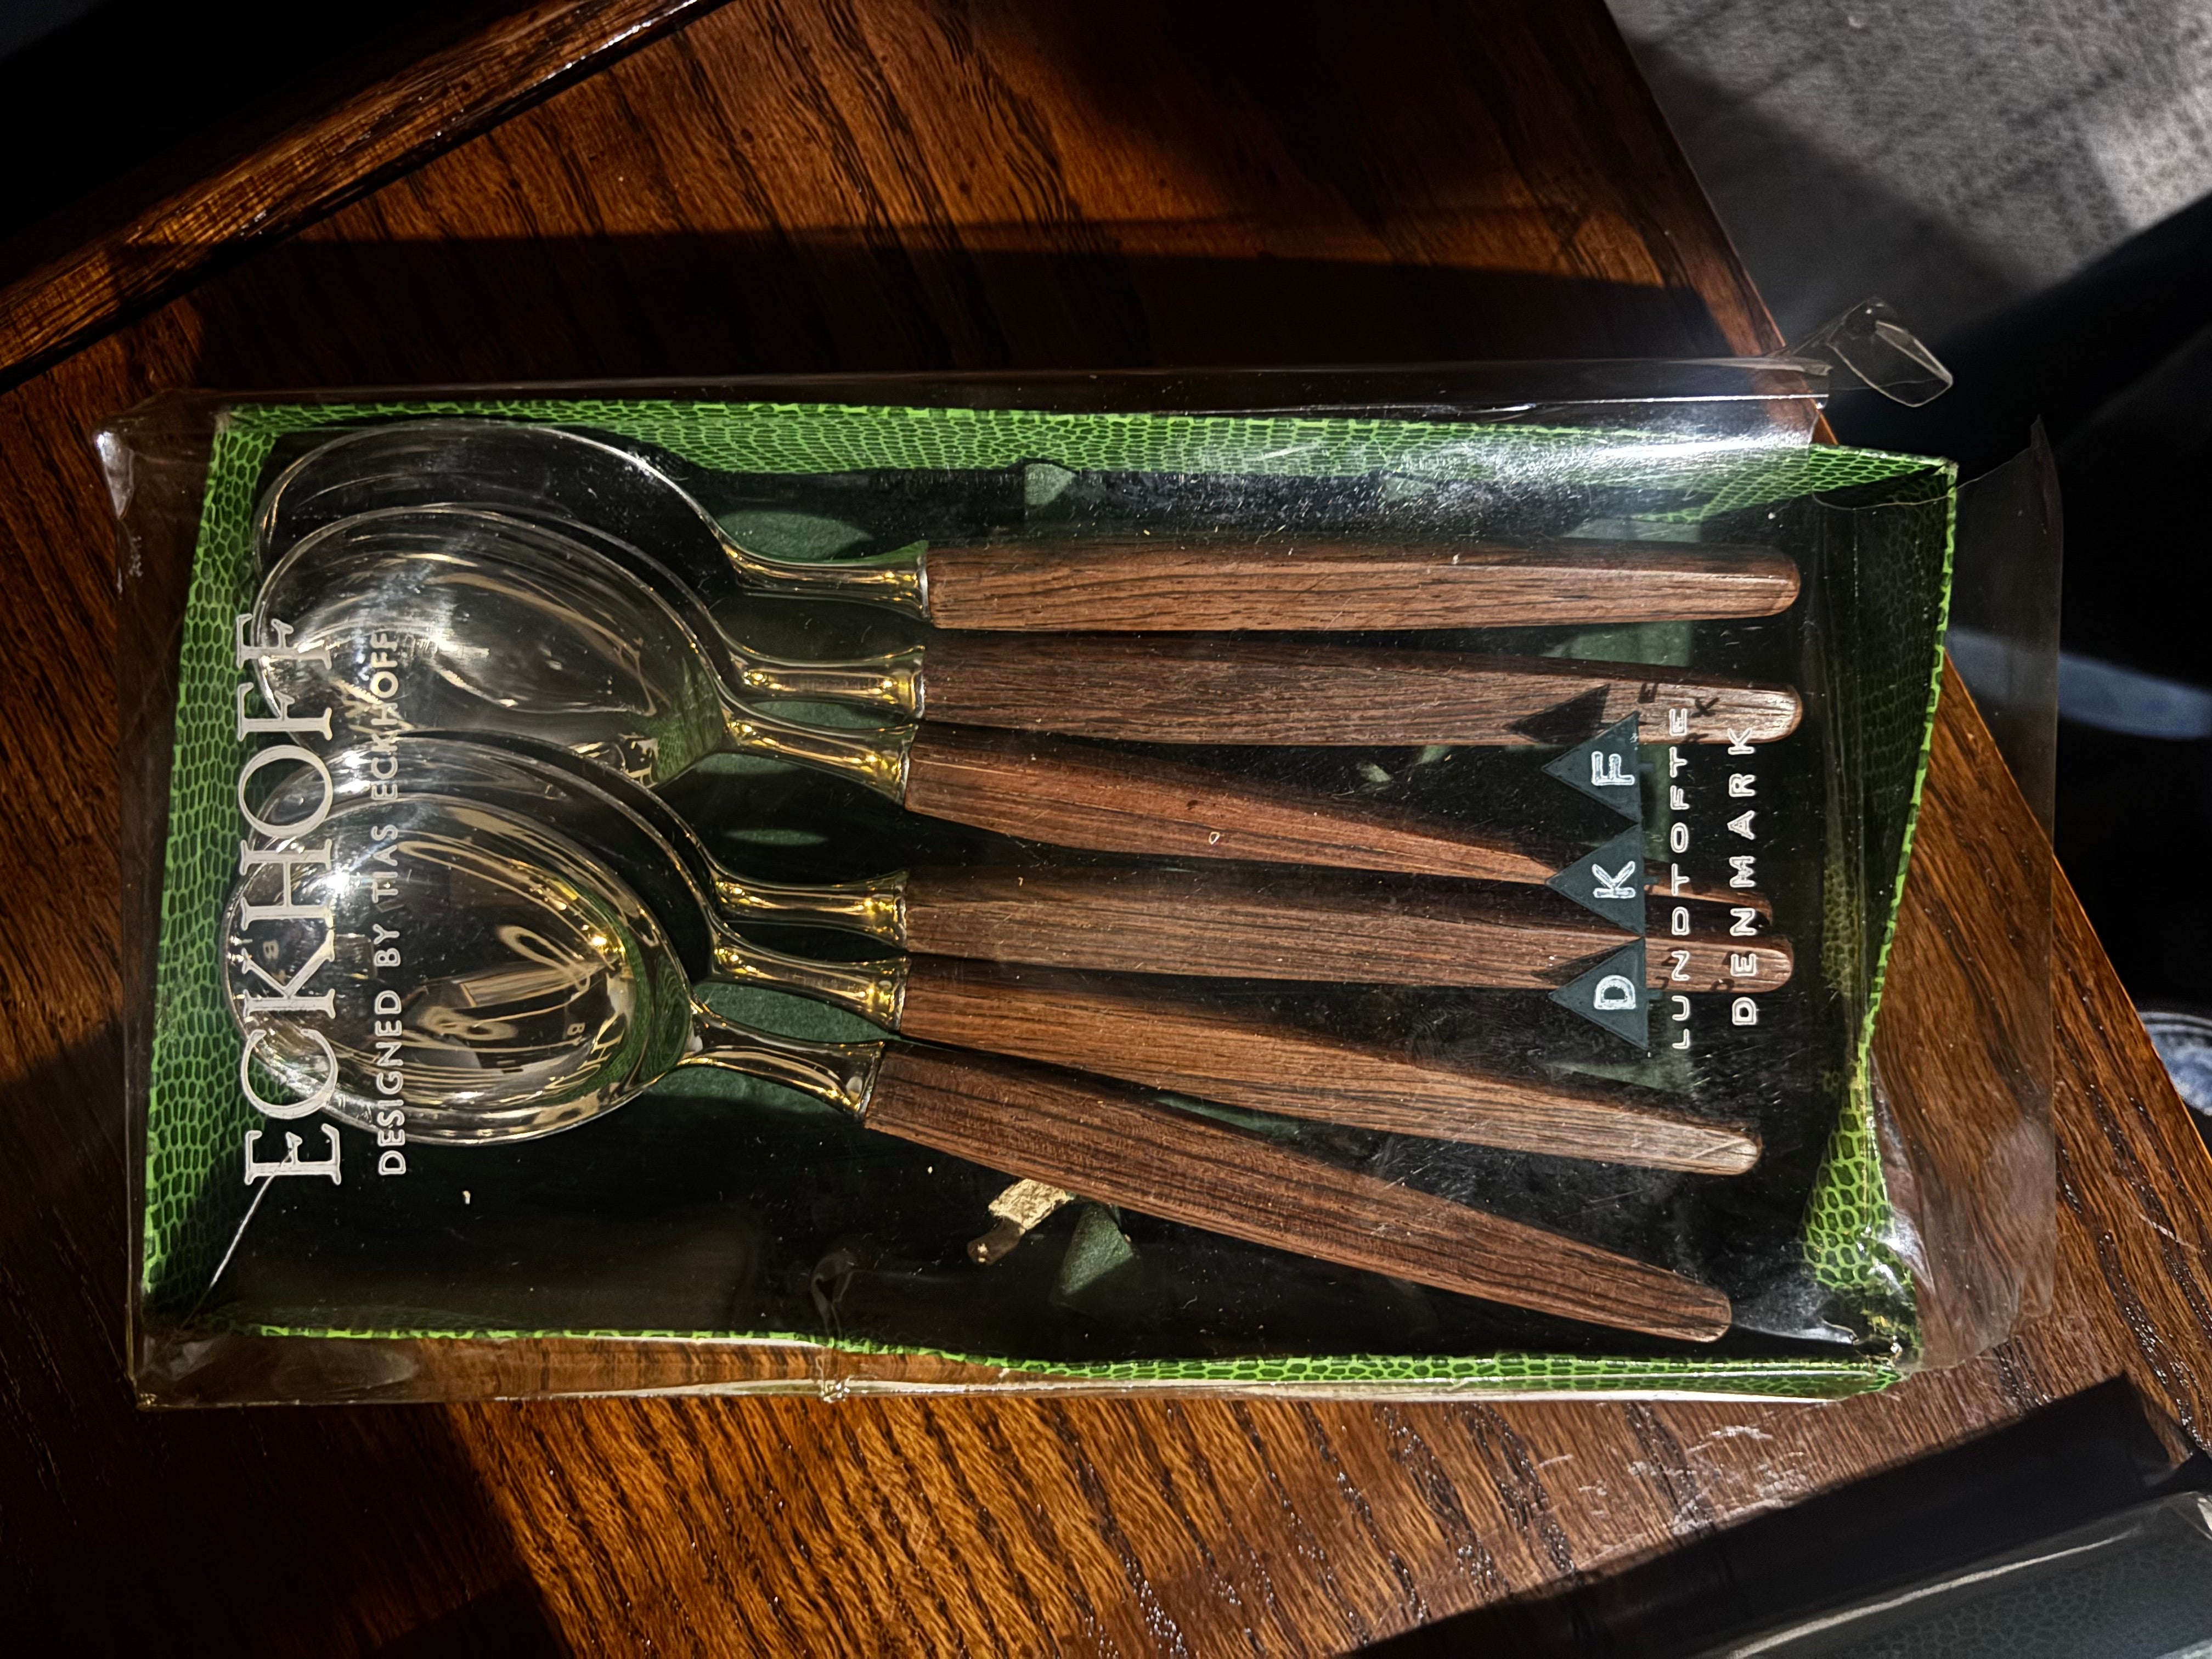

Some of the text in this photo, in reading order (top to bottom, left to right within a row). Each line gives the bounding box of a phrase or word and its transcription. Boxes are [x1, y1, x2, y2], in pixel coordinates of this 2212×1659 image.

[236, 613, 341, 1185] ECKHOFF
[370, 633, 407, 1175] DESIGNED BY TIAS ECKHOFF
[1669, 708, 1691, 1049] LUNDTOFTE
[1727, 727, 1757, 1026] DENMARK
